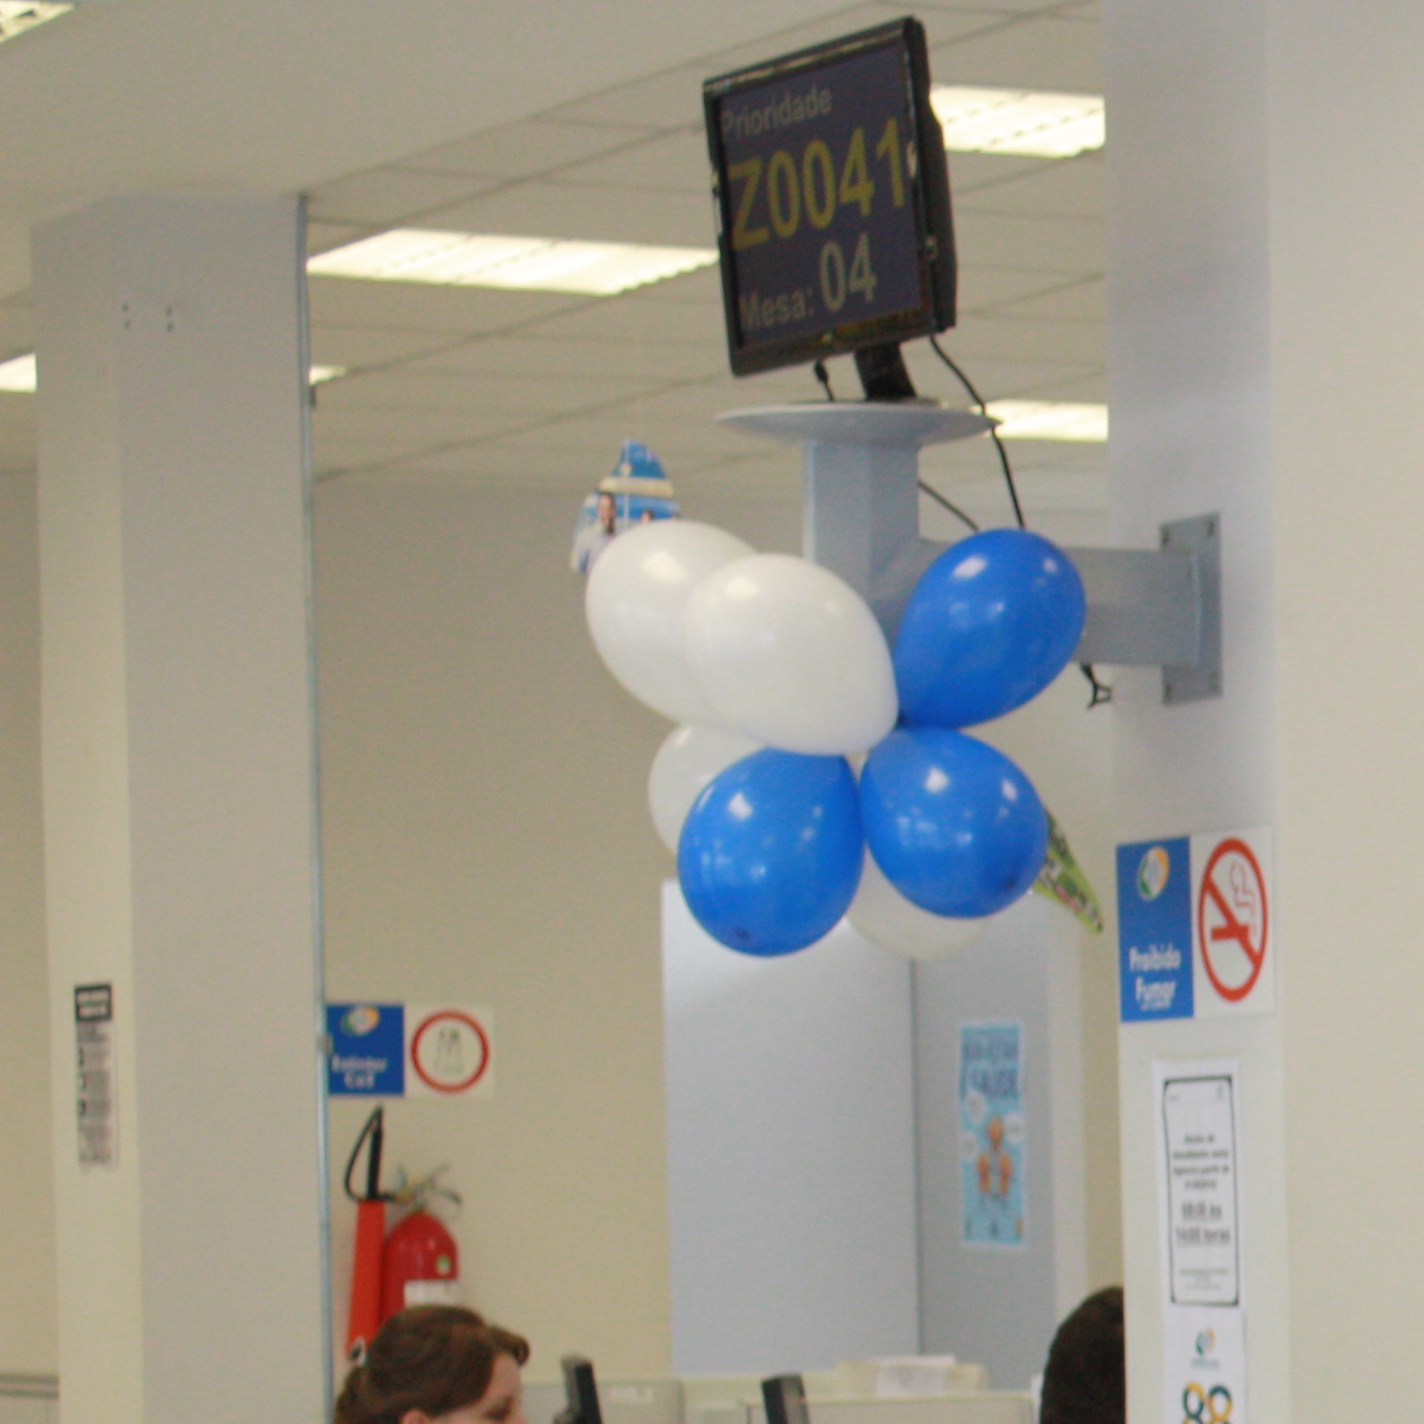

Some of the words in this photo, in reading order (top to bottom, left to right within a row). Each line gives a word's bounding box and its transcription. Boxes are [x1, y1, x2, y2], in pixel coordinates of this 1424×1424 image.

[722, 84, 832, 138] Prioridade
[728, 118, 905, 249] Z0041
[738, 287, 815, 330] Mesa:
[819, 233, 877, 312] 04
